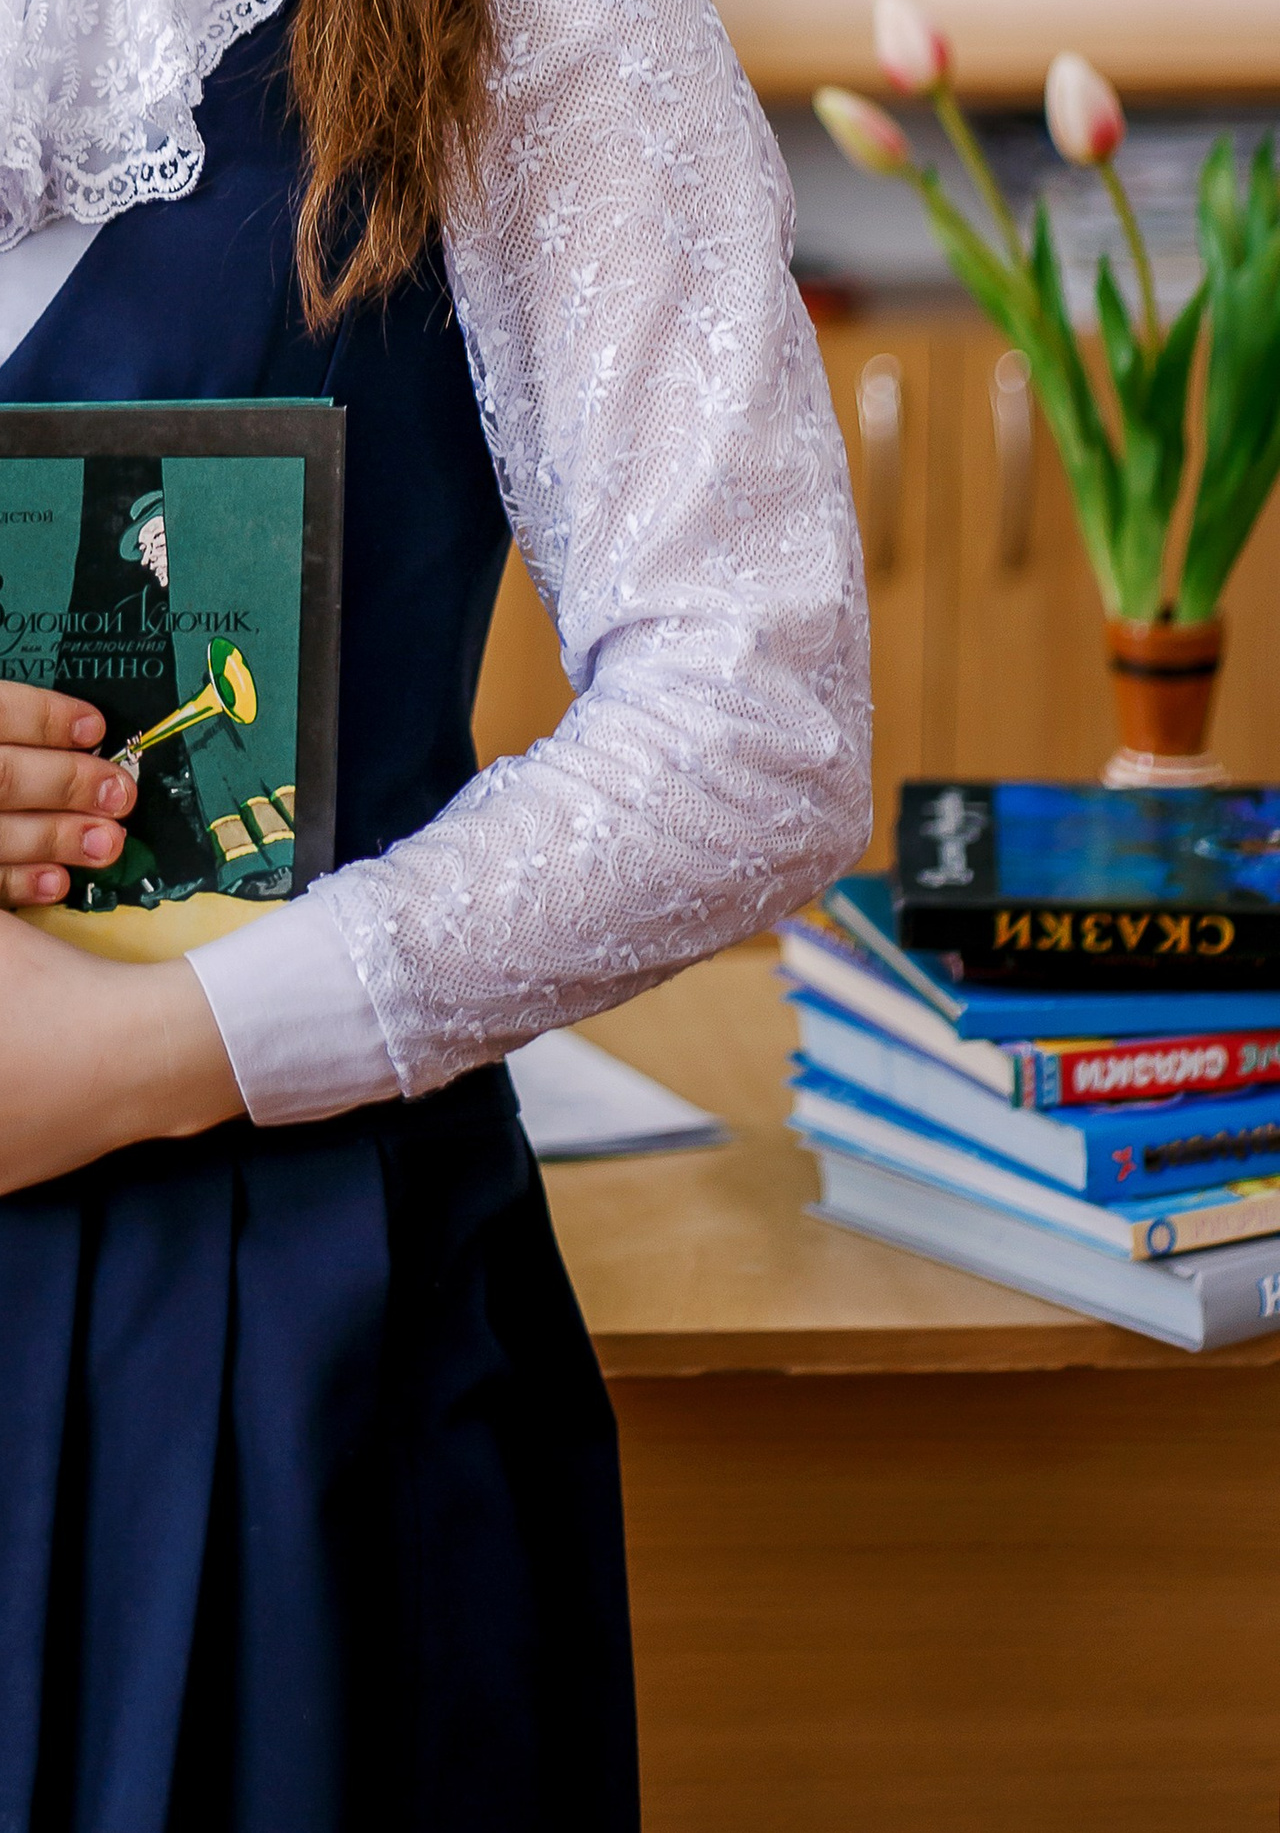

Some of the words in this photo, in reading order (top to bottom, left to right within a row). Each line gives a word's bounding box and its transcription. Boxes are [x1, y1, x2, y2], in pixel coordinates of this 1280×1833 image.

[1, 656, 165, 681] БУРАТИНО
[992, 910, 1237, 956] СКАЗКИ
[1073, 1045, 1230, 1094] СКАЗКИ
